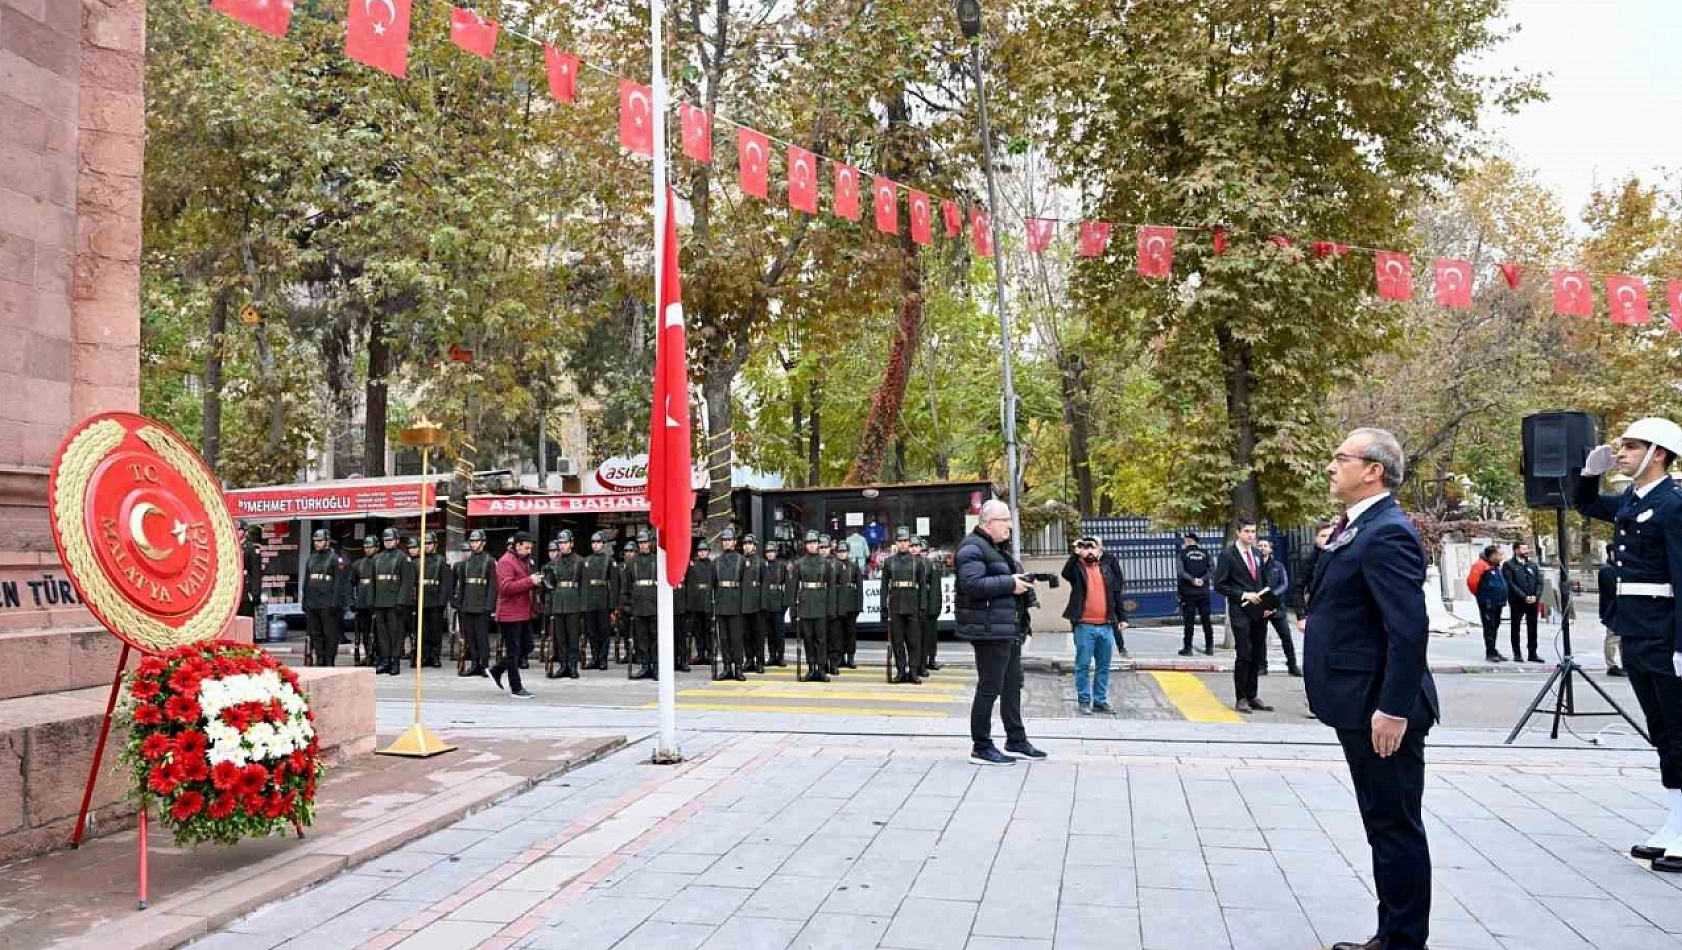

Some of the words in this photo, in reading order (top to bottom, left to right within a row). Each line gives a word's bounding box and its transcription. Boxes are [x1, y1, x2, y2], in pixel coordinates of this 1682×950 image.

[248, 499, 293, 513] MEHMET
[295, 495, 351, 510] TÜRKOĞLU
[489, 499, 563, 512] ASUDE
[102, 516, 173, 604] MALATYA
[0, 581, 20, 607] N
[27, 574, 83, 606] TÜR
